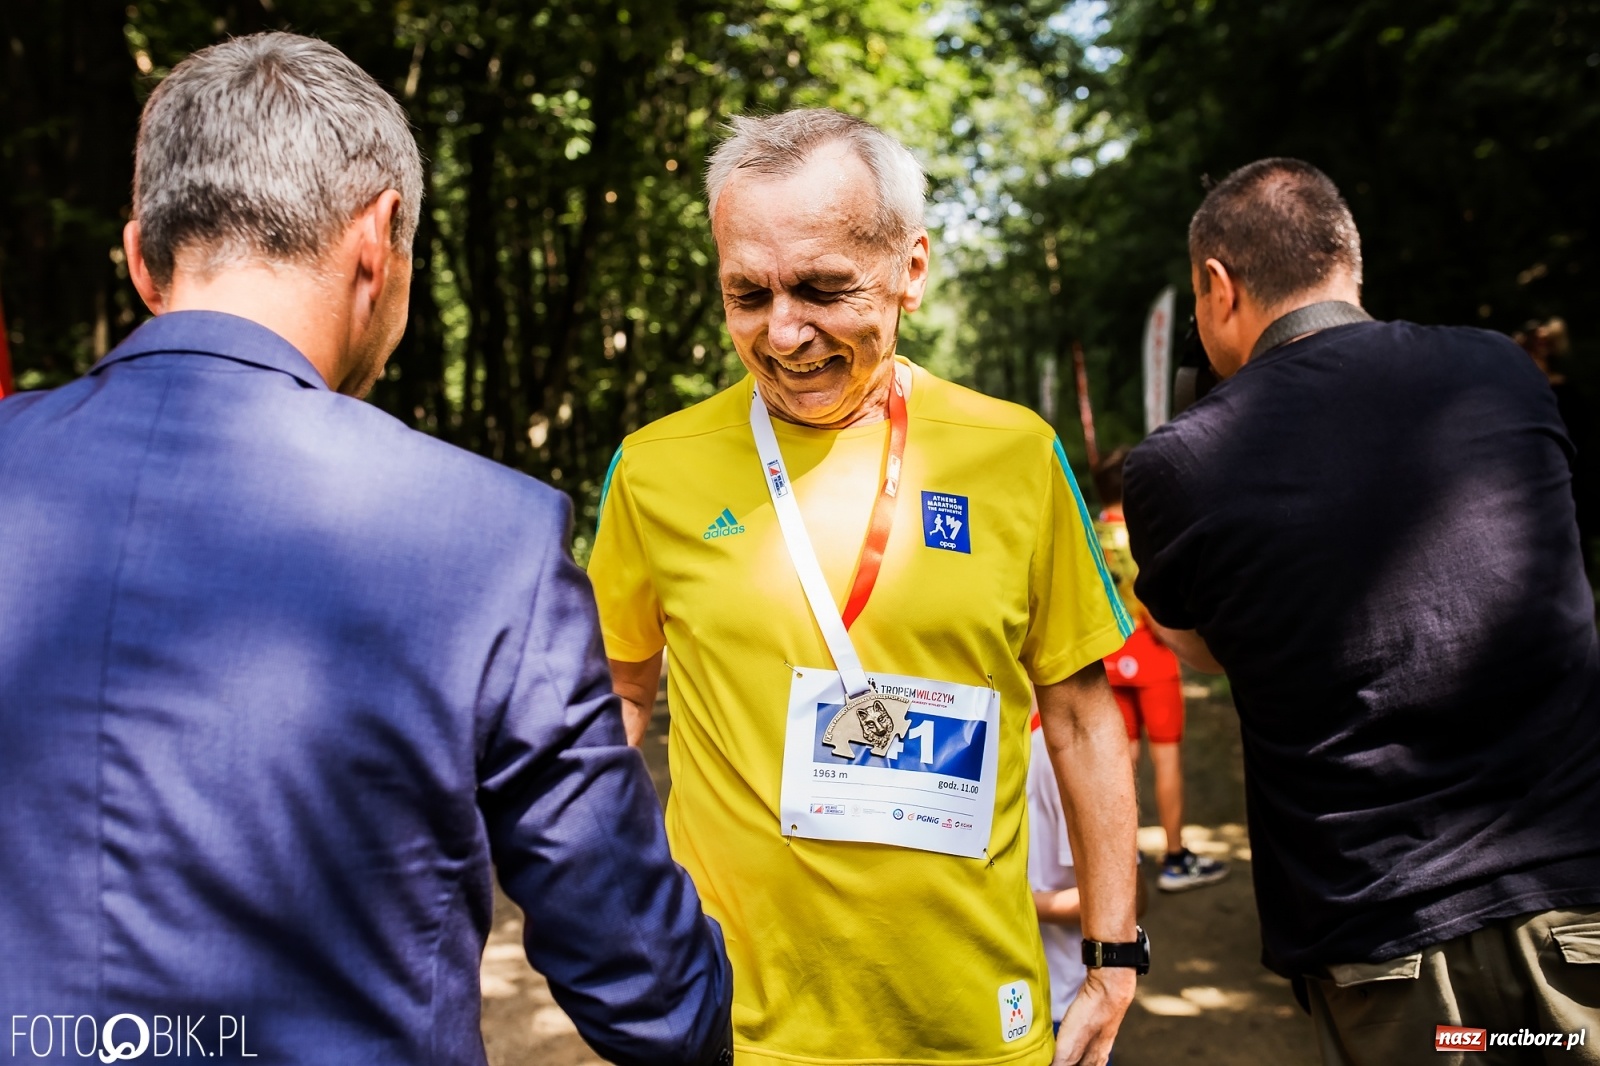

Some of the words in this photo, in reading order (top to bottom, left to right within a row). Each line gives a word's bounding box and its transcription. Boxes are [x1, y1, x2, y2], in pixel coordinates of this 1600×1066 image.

[932, 495, 957, 504] ATHENS
[927, 501, 962, 511] MARATHON
[703, 525, 745, 540] adidas
[813, 769, 836, 778] 1963
[938, 780, 959, 791] godz.
[961, 784, 979, 794] 11.00
[916, 814, 940, 825] PGNiG
